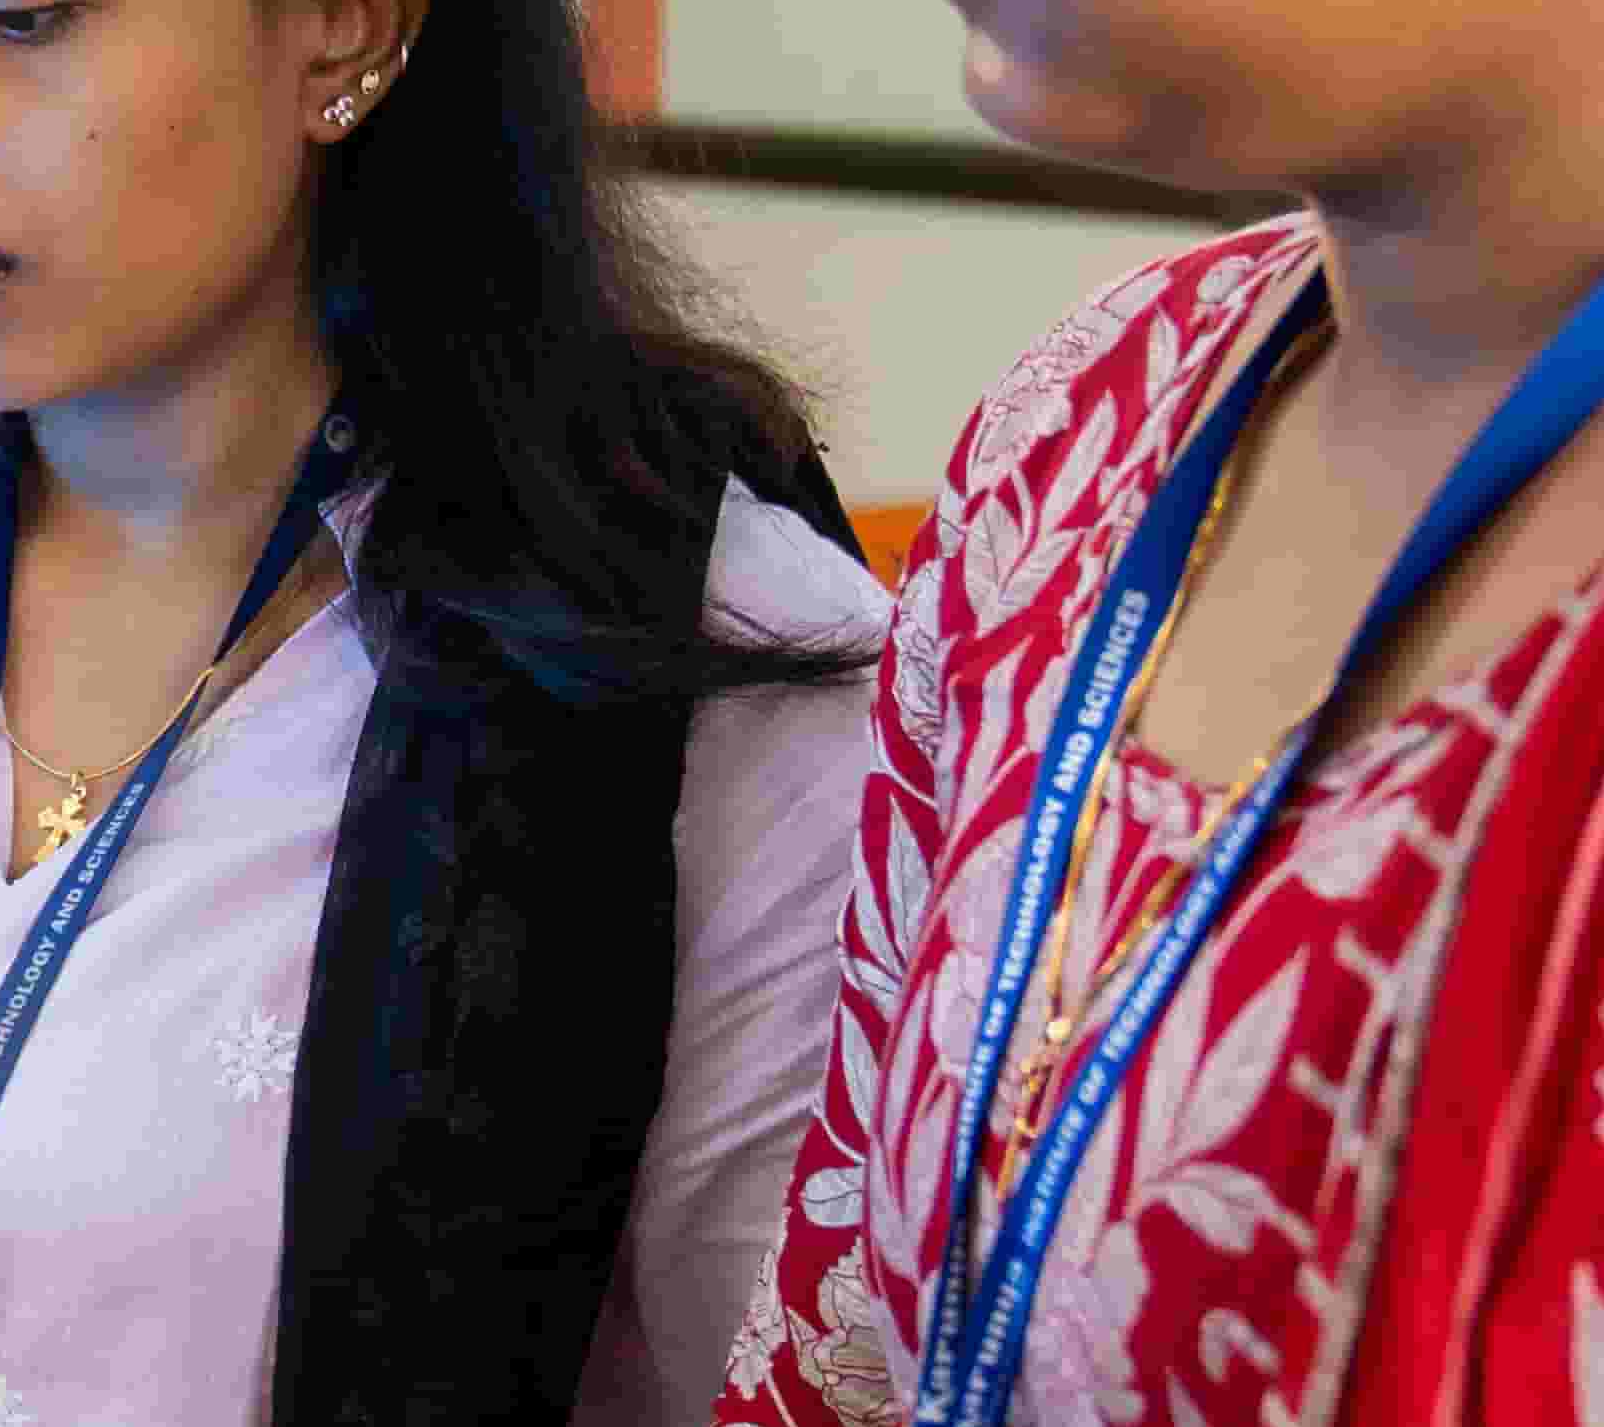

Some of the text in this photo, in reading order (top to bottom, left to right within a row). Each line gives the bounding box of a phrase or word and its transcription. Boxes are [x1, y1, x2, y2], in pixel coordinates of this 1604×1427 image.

[50, 886, 84, 934] AND
[77, 782, 146, 886] SCIENCES
[983, 996, 1006, 1038] OF
[996, 794, 1066, 994] TECHNOLOGY
[1050, 730, 1094, 794] AND
[1076, 588, 1150, 730] SCIENCES
